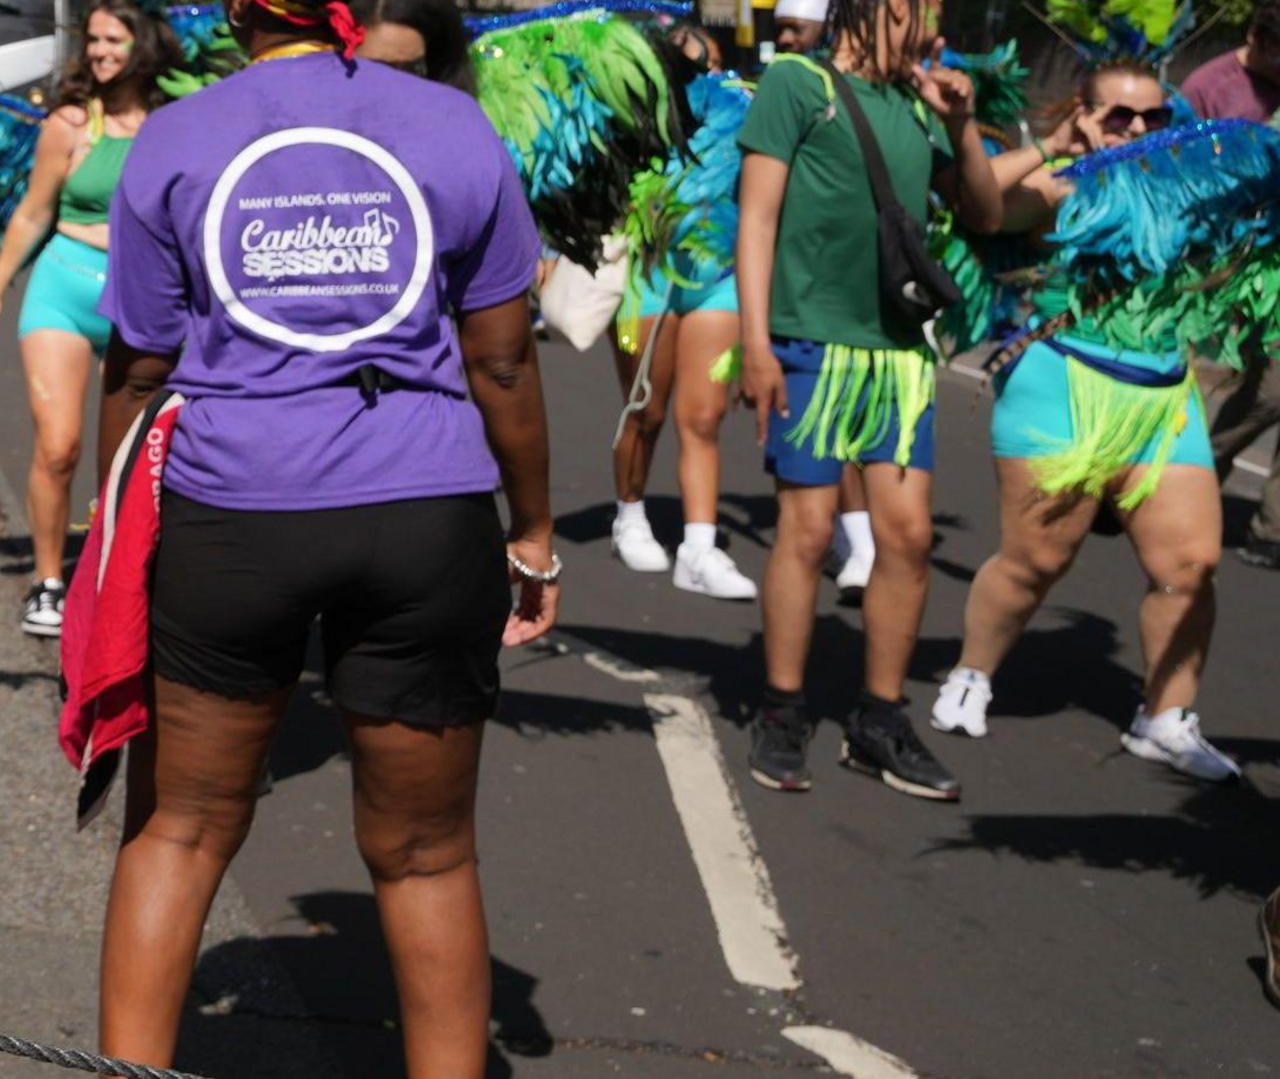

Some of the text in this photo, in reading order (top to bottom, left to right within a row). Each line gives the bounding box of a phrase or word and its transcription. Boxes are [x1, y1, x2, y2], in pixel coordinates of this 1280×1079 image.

[239, 197, 272, 210] MANY
[327, 192, 351, 205] ONE
[352, 191, 391, 204] VISION
[241, 215, 383, 253] Caribbean
[243, 247, 389, 278] SESSIONS
